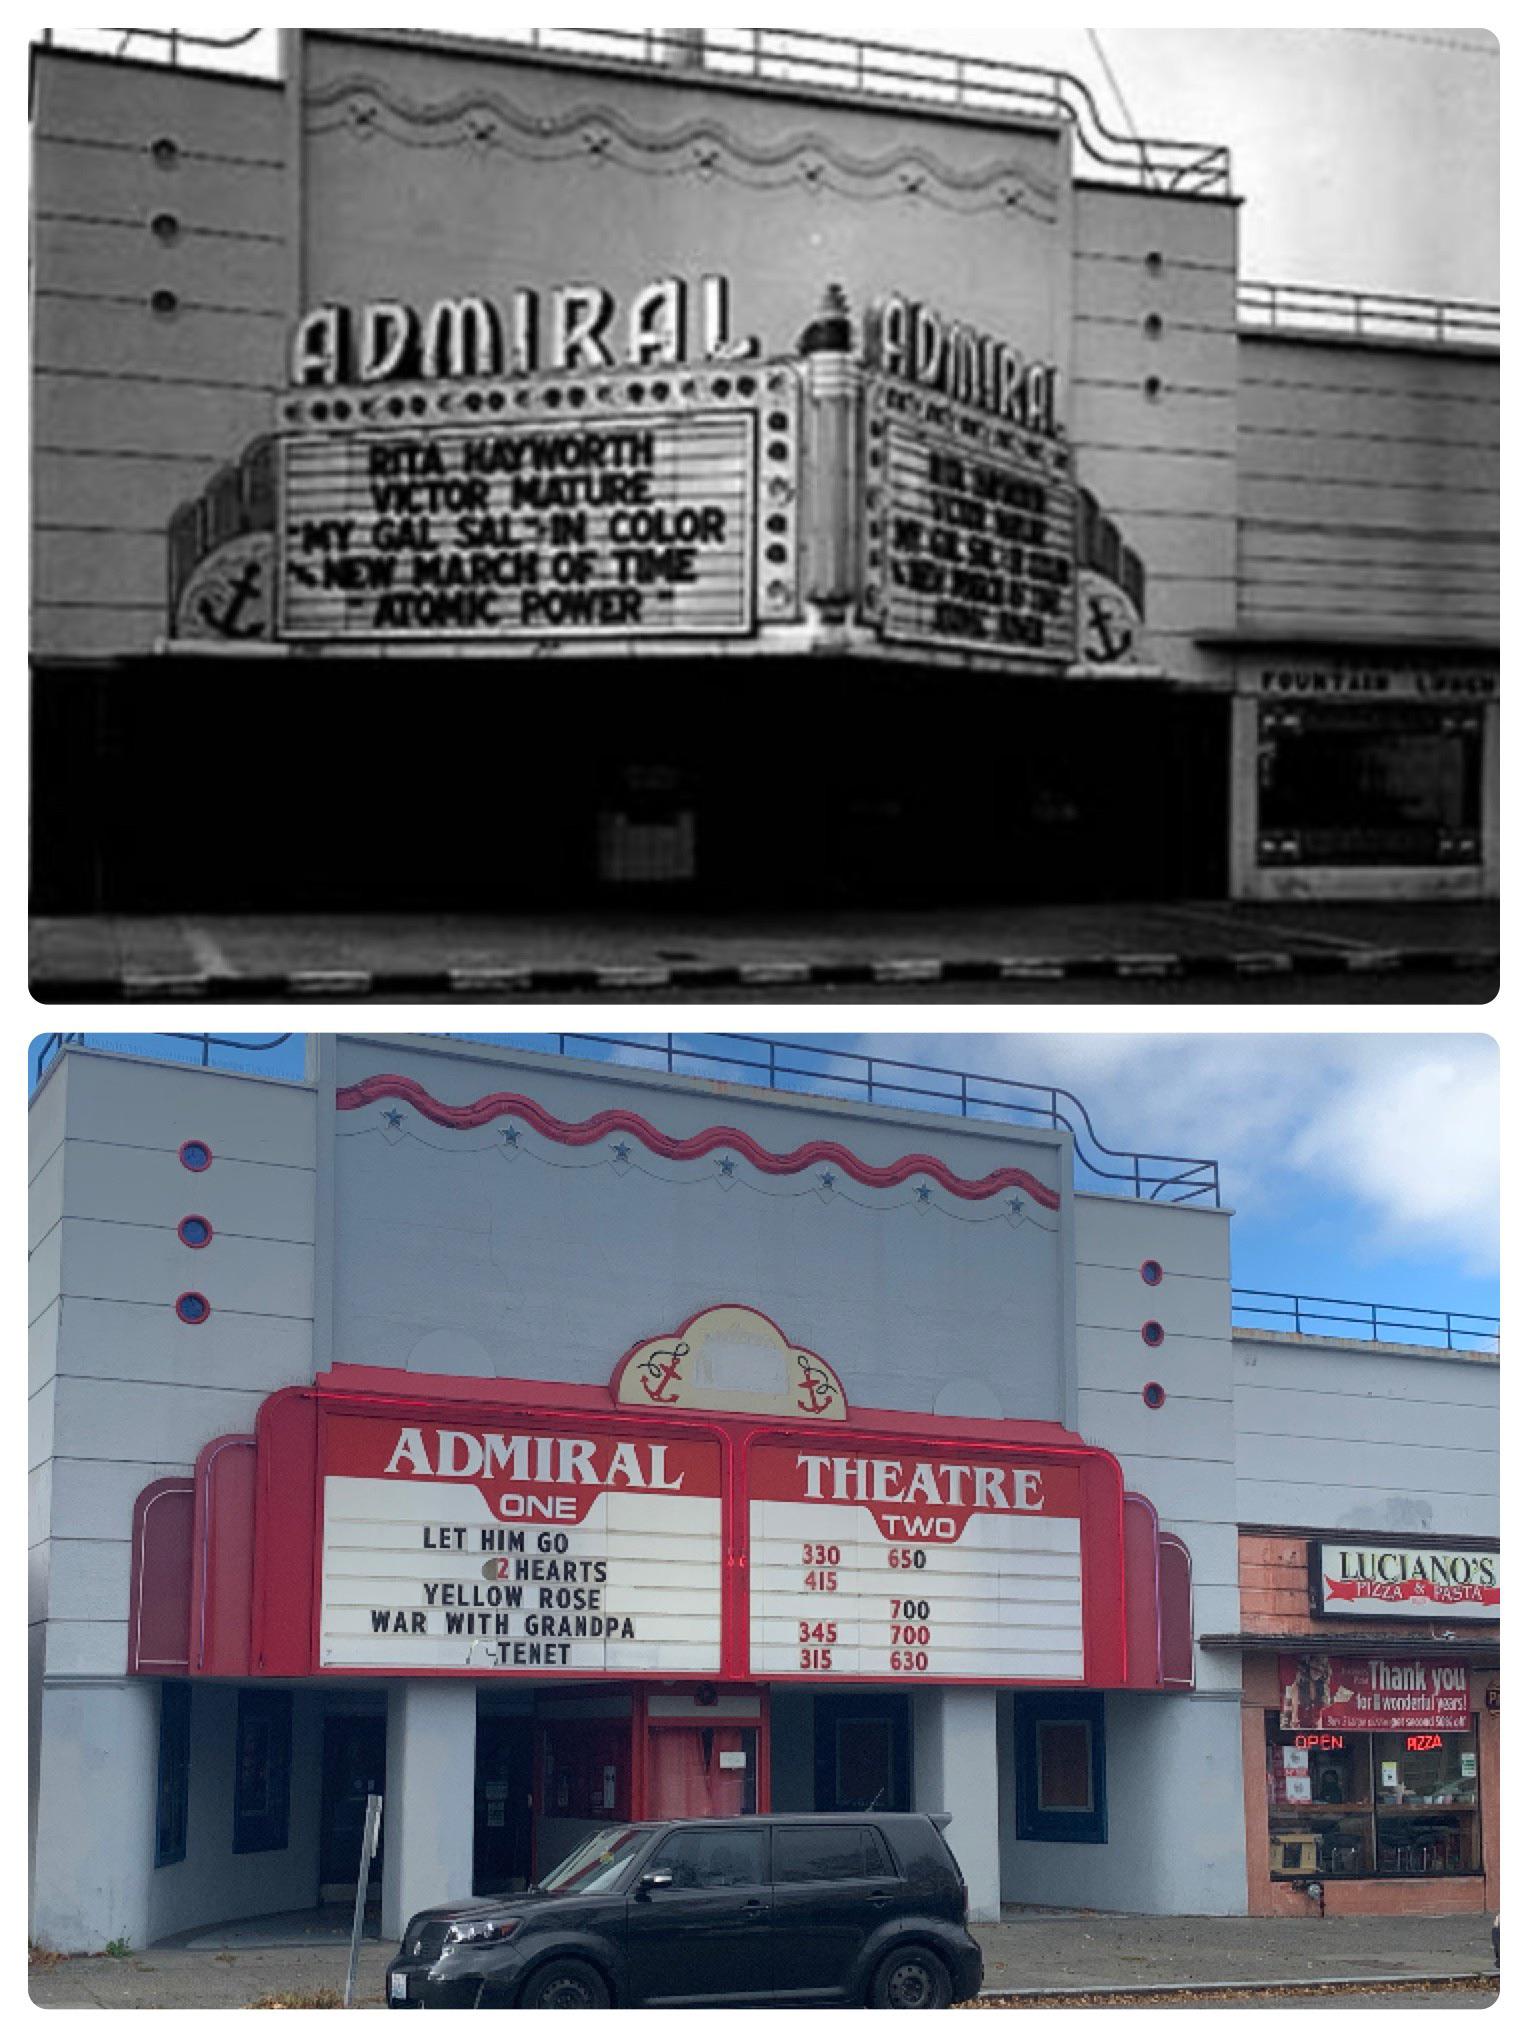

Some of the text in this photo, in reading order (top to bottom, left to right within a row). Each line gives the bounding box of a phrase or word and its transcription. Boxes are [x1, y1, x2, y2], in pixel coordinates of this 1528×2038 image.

[292, 276, 759, 386] ADMIRAL
[368, 446, 444, 477] RITA
[368, 474, 655, 514] VICTOR MATURE
[372, 516, 438, 552] GAL
[551, 512, 587, 546] IN
[609, 507, 726, 544] COLOR
[413, 551, 538, 585] MARCH
[551, 551, 598, 583] OF
[610, 548, 699, 584] TIME
[373, 588, 644, 628] ATOMIC POWER
[384, 1427, 684, 1491] ADMIRAL
[797, 1455, 1045, 1511] THEATRE
[499, 1493, 577, 1520] ONE
[881, 1514, 956, 1538] TWO
[423, 1526, 569, 1554] LET HIM GO
[802, 1544, 841, 1566] 330
[888, 1549, 927, 1570] 650
[497, 1557, 608, 1583] 2 HEARTS
[804, 1571, 838, 1592] 415
[1339, 1551, 1497, 1587] LUCIANO'S
[424, 1584, 601, 1611] YELLOW ROSE
[1356, 1581, 1404, 1600] PIZZA
[1414, 1582, 1425, 1596] &
[1433, 1584, 1483, 1601] PASTA
[890, 1600, 931, 1621] 700
[371, 1610, 636, 1640] WAR WITH GRANDPA
[799, 1623, 838, 1644] 345
[890, 1625, 931, 1646] 700
[498, 1642, 572, 1666] TENET
[800, 1650, 833, 1670] 315
[890, 1651, 929, 1672] 630
[1368, 1660, 1427, 1691] Thank
[1431, 1666, 1467, 1697] you
[1356, 1693, 1372, 1711] for
[1383, 1692, 1435, 1712] wonderful
[1295, 1735, 1343, 1749] OPEN
[1406, 1734, 1443, 1750] PIZZA
